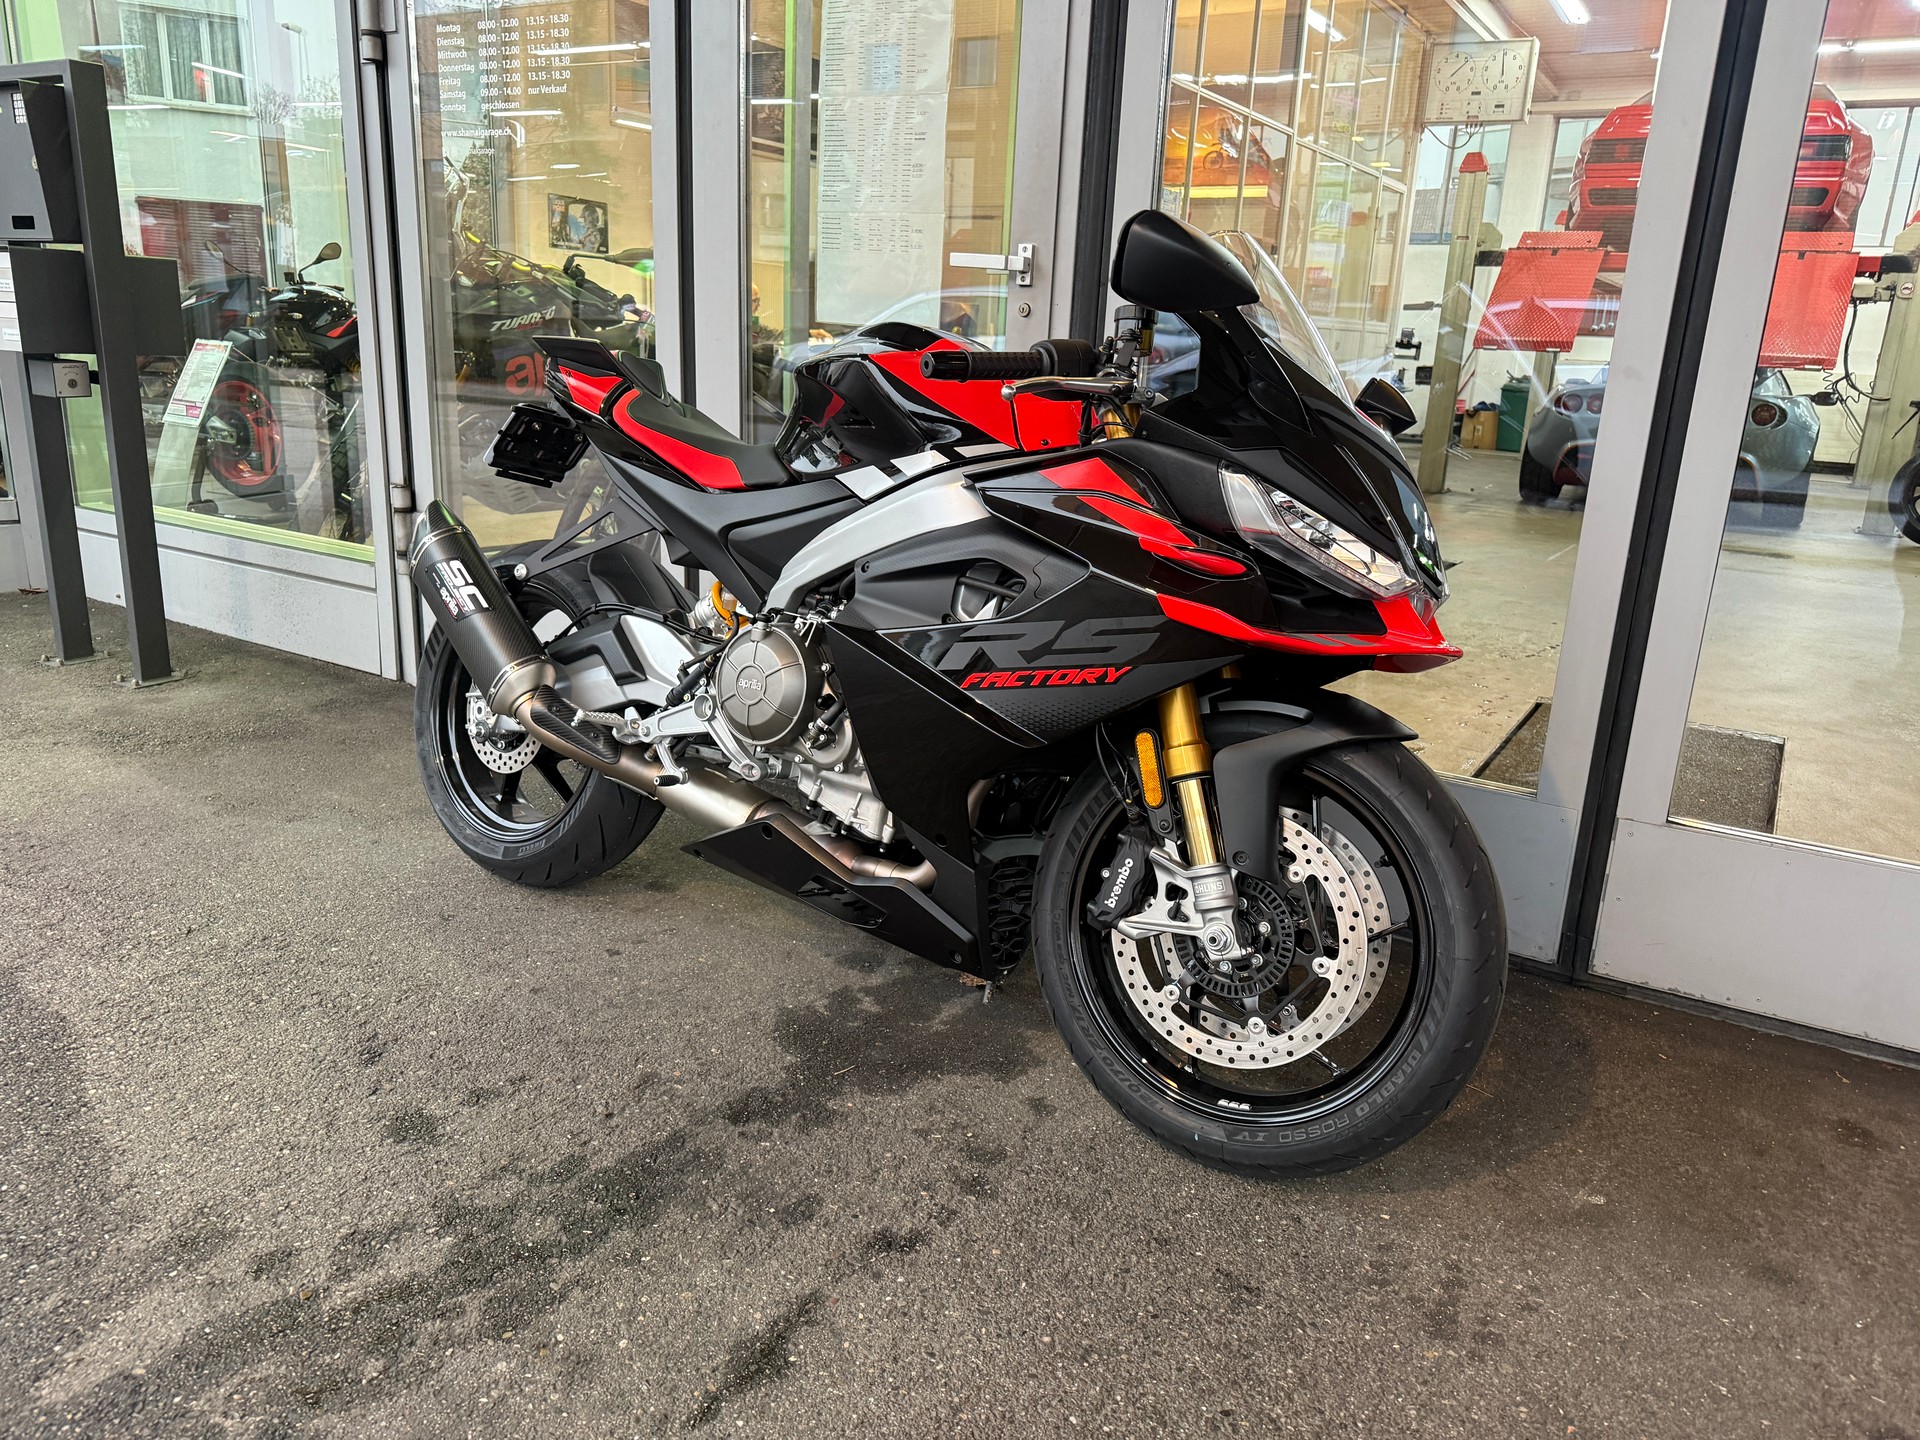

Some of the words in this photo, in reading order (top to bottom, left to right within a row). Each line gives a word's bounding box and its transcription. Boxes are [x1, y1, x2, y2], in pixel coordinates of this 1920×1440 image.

[437, 24, 460, 33] Montag
[478, 20, 495, 29] 08.00
[501, 18, 518, 27] 12.00
[526, 16, 544, 25] 13.15
[550, 14, 569, 23] 18.30
[437, 37, 464, 46] Dienstag
[478, 34, 496, 43] 08.00
[501, 32, 519, 41] 12.00
[526, 30, 544, 39] 13.15
[550, 28, 569, 37] 18.30
[438, 50, 466, 59] Mittwoch
[479, 48, 496, 56] 08.00
[502, 46, 519, 55] 12.00
[527, 44, 545, 53] 13.15
[438, 64, 474, 73] Donnerstag
[479, 61, 497, 70] 08.00
[502, 60, 520, 68] 12.00
[527, 58, 545, 67] 13.15
[551, 56, 570, 65] 18.30
[439, 78, 460, 86] Freitag
[480, 75, 497, 83] 08.00
[503, 73, 520, 82] 12.00
[528, 72, 546, 81] 13.15
[552, 70, 570, 79] 18.30
[440, 90, 466, 99] Samstag
[481, 88, 498, 97] 09.00
[504, 87, 521, 95] 14.00
[540, 84, 567, 94] Verkauf
[440, 103, 466, 112] Sonntag
[481, 100, 520, 112] geschlossen
[441, 126, 511, 137] www.shamalgarage.ch
[449, 560, 489, 611] SC
[935, 614, 1170, 671] RS
[960, 666, 1132, 689] FACTORY
[1104, 858, 1133, 908] brembo
[1355, 1049, 1421, 1117] DIABLO
[1232, 1132, 1269, 1142] IV
[1279, 1114, 1349, 1143] ROSSO
